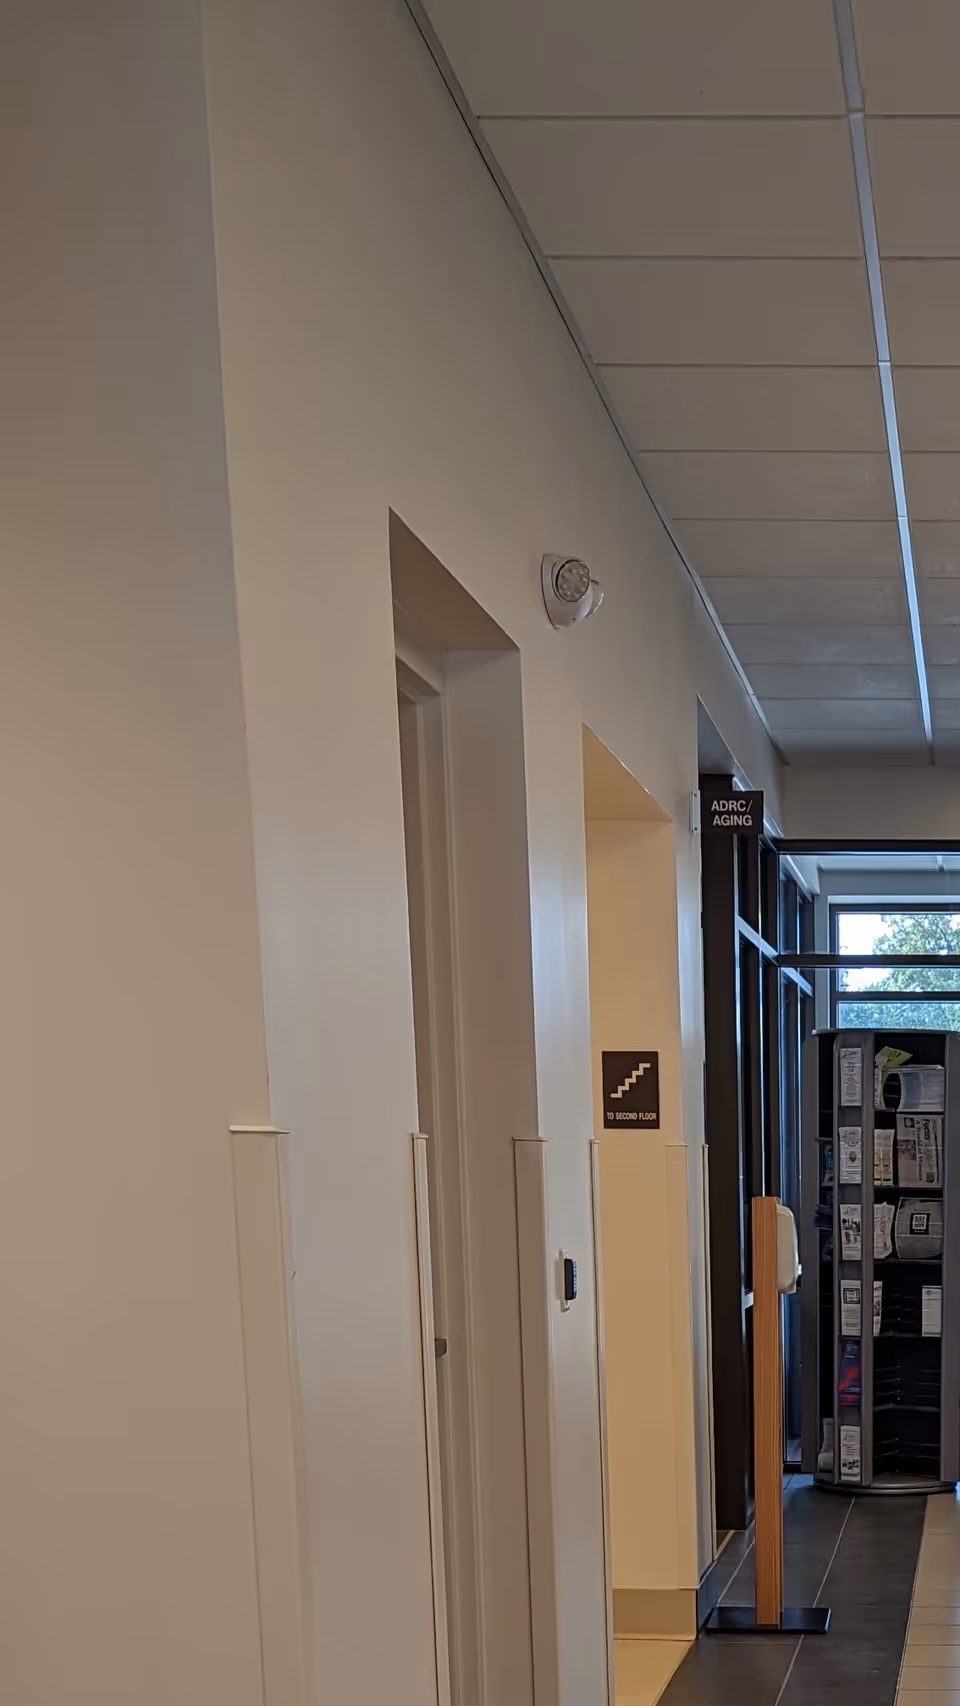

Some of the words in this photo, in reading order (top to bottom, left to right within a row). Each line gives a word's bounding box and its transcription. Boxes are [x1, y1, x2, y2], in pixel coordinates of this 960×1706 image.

[711, 800, 752, 813] ADRC/
[713, 815, 752, 826] AGING
[606, 1112, 614, 1120] TO
[615, 1112, 638, 1120] SECOND
[639, 1112, 657, 1120] FLOOR
